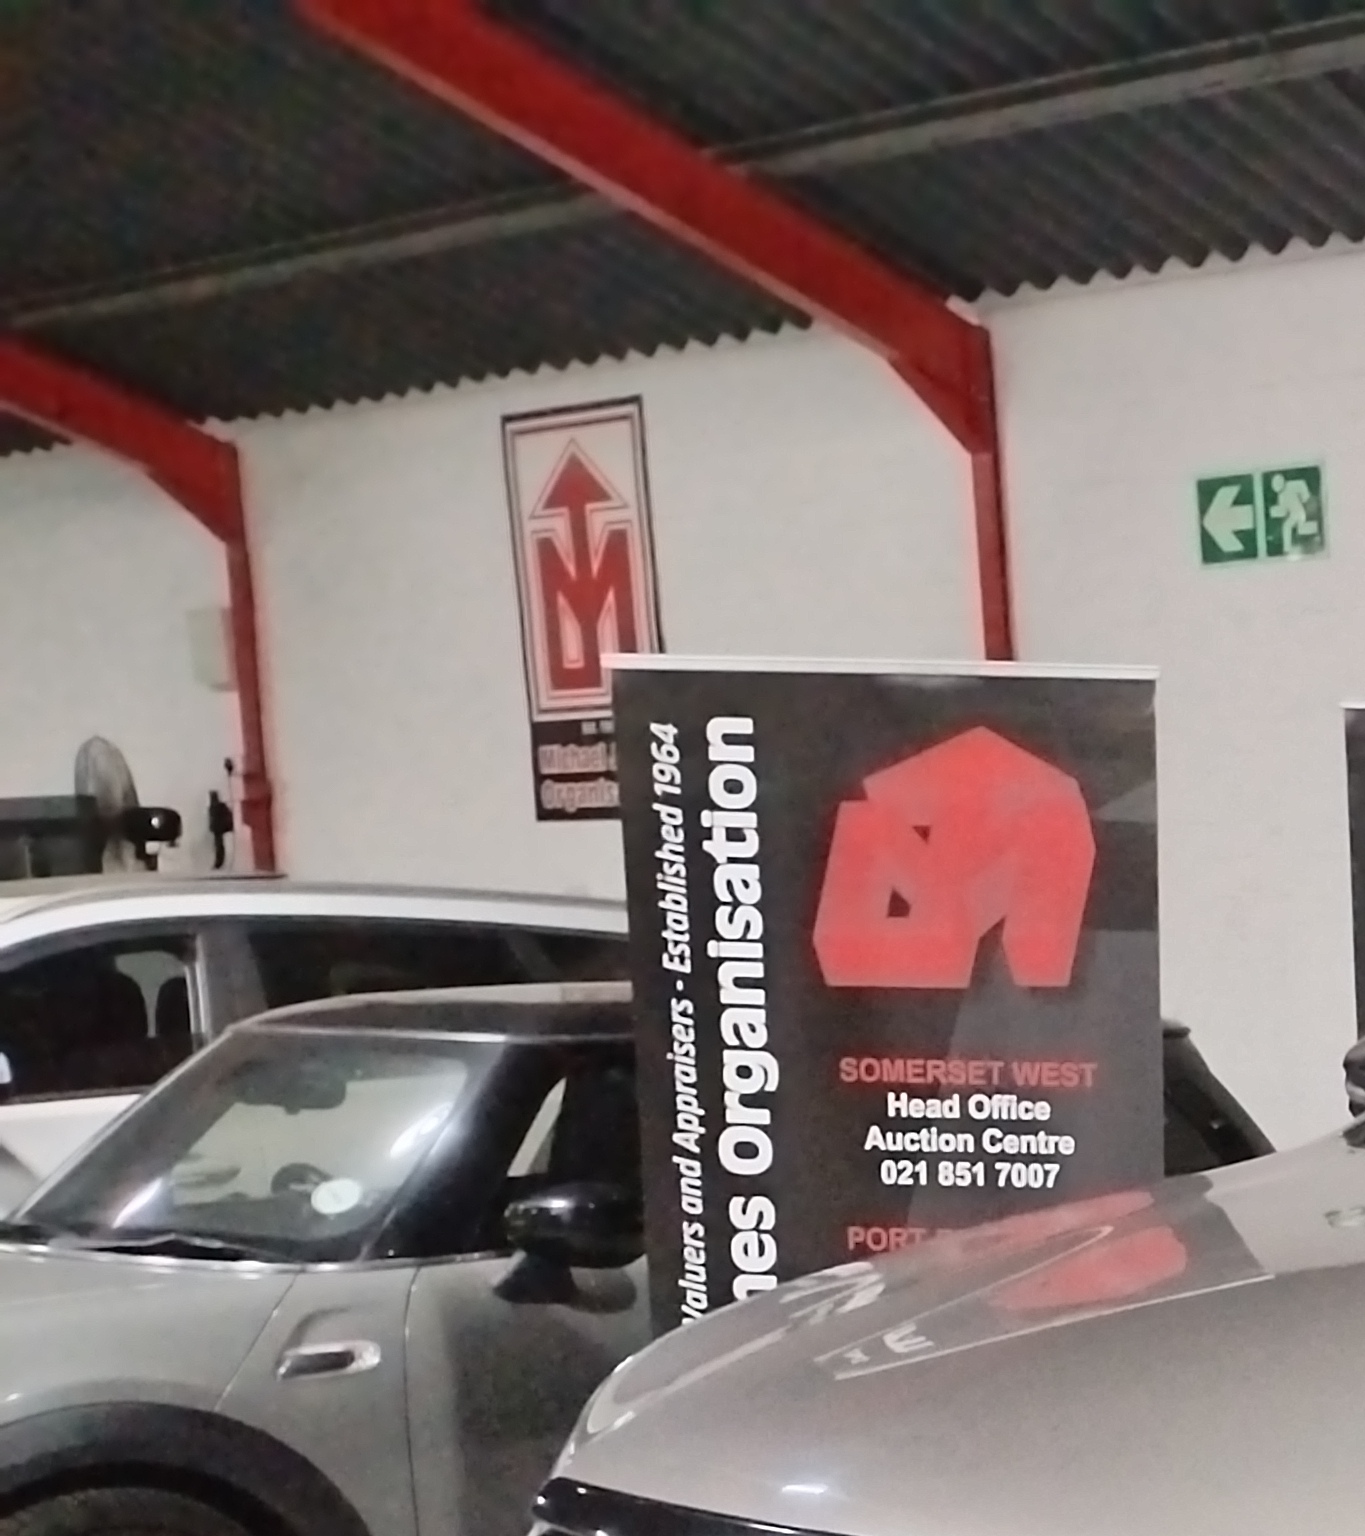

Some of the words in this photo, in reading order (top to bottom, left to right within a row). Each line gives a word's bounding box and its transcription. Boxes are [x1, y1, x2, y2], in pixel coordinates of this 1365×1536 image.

[650, 721, 682, 797] 1964
[652, 802, 692, 974] Established
[700, 716, 779, 1176] Organisation
[666, 998, 706, 1152] Appraisers
[839, 1057, 1005, 1086] SOMERSET
[1012, 1061, 1098, 1088] WEST
[887, 1091, 960, 1119] Head
[967, 1093, 1051, 1121] Office
[864, 1125, 974, 1153] Auction
[982, 1128, 1076, 1155] Centre
[671, 1155, 704, 1215] and
[880, 1159, 928, 1185] 021
[938, 1161, 985, 1187] 851
[995, 1163, 1061, 1189] 7007
[847, 1225, 926, 1251] PORT
